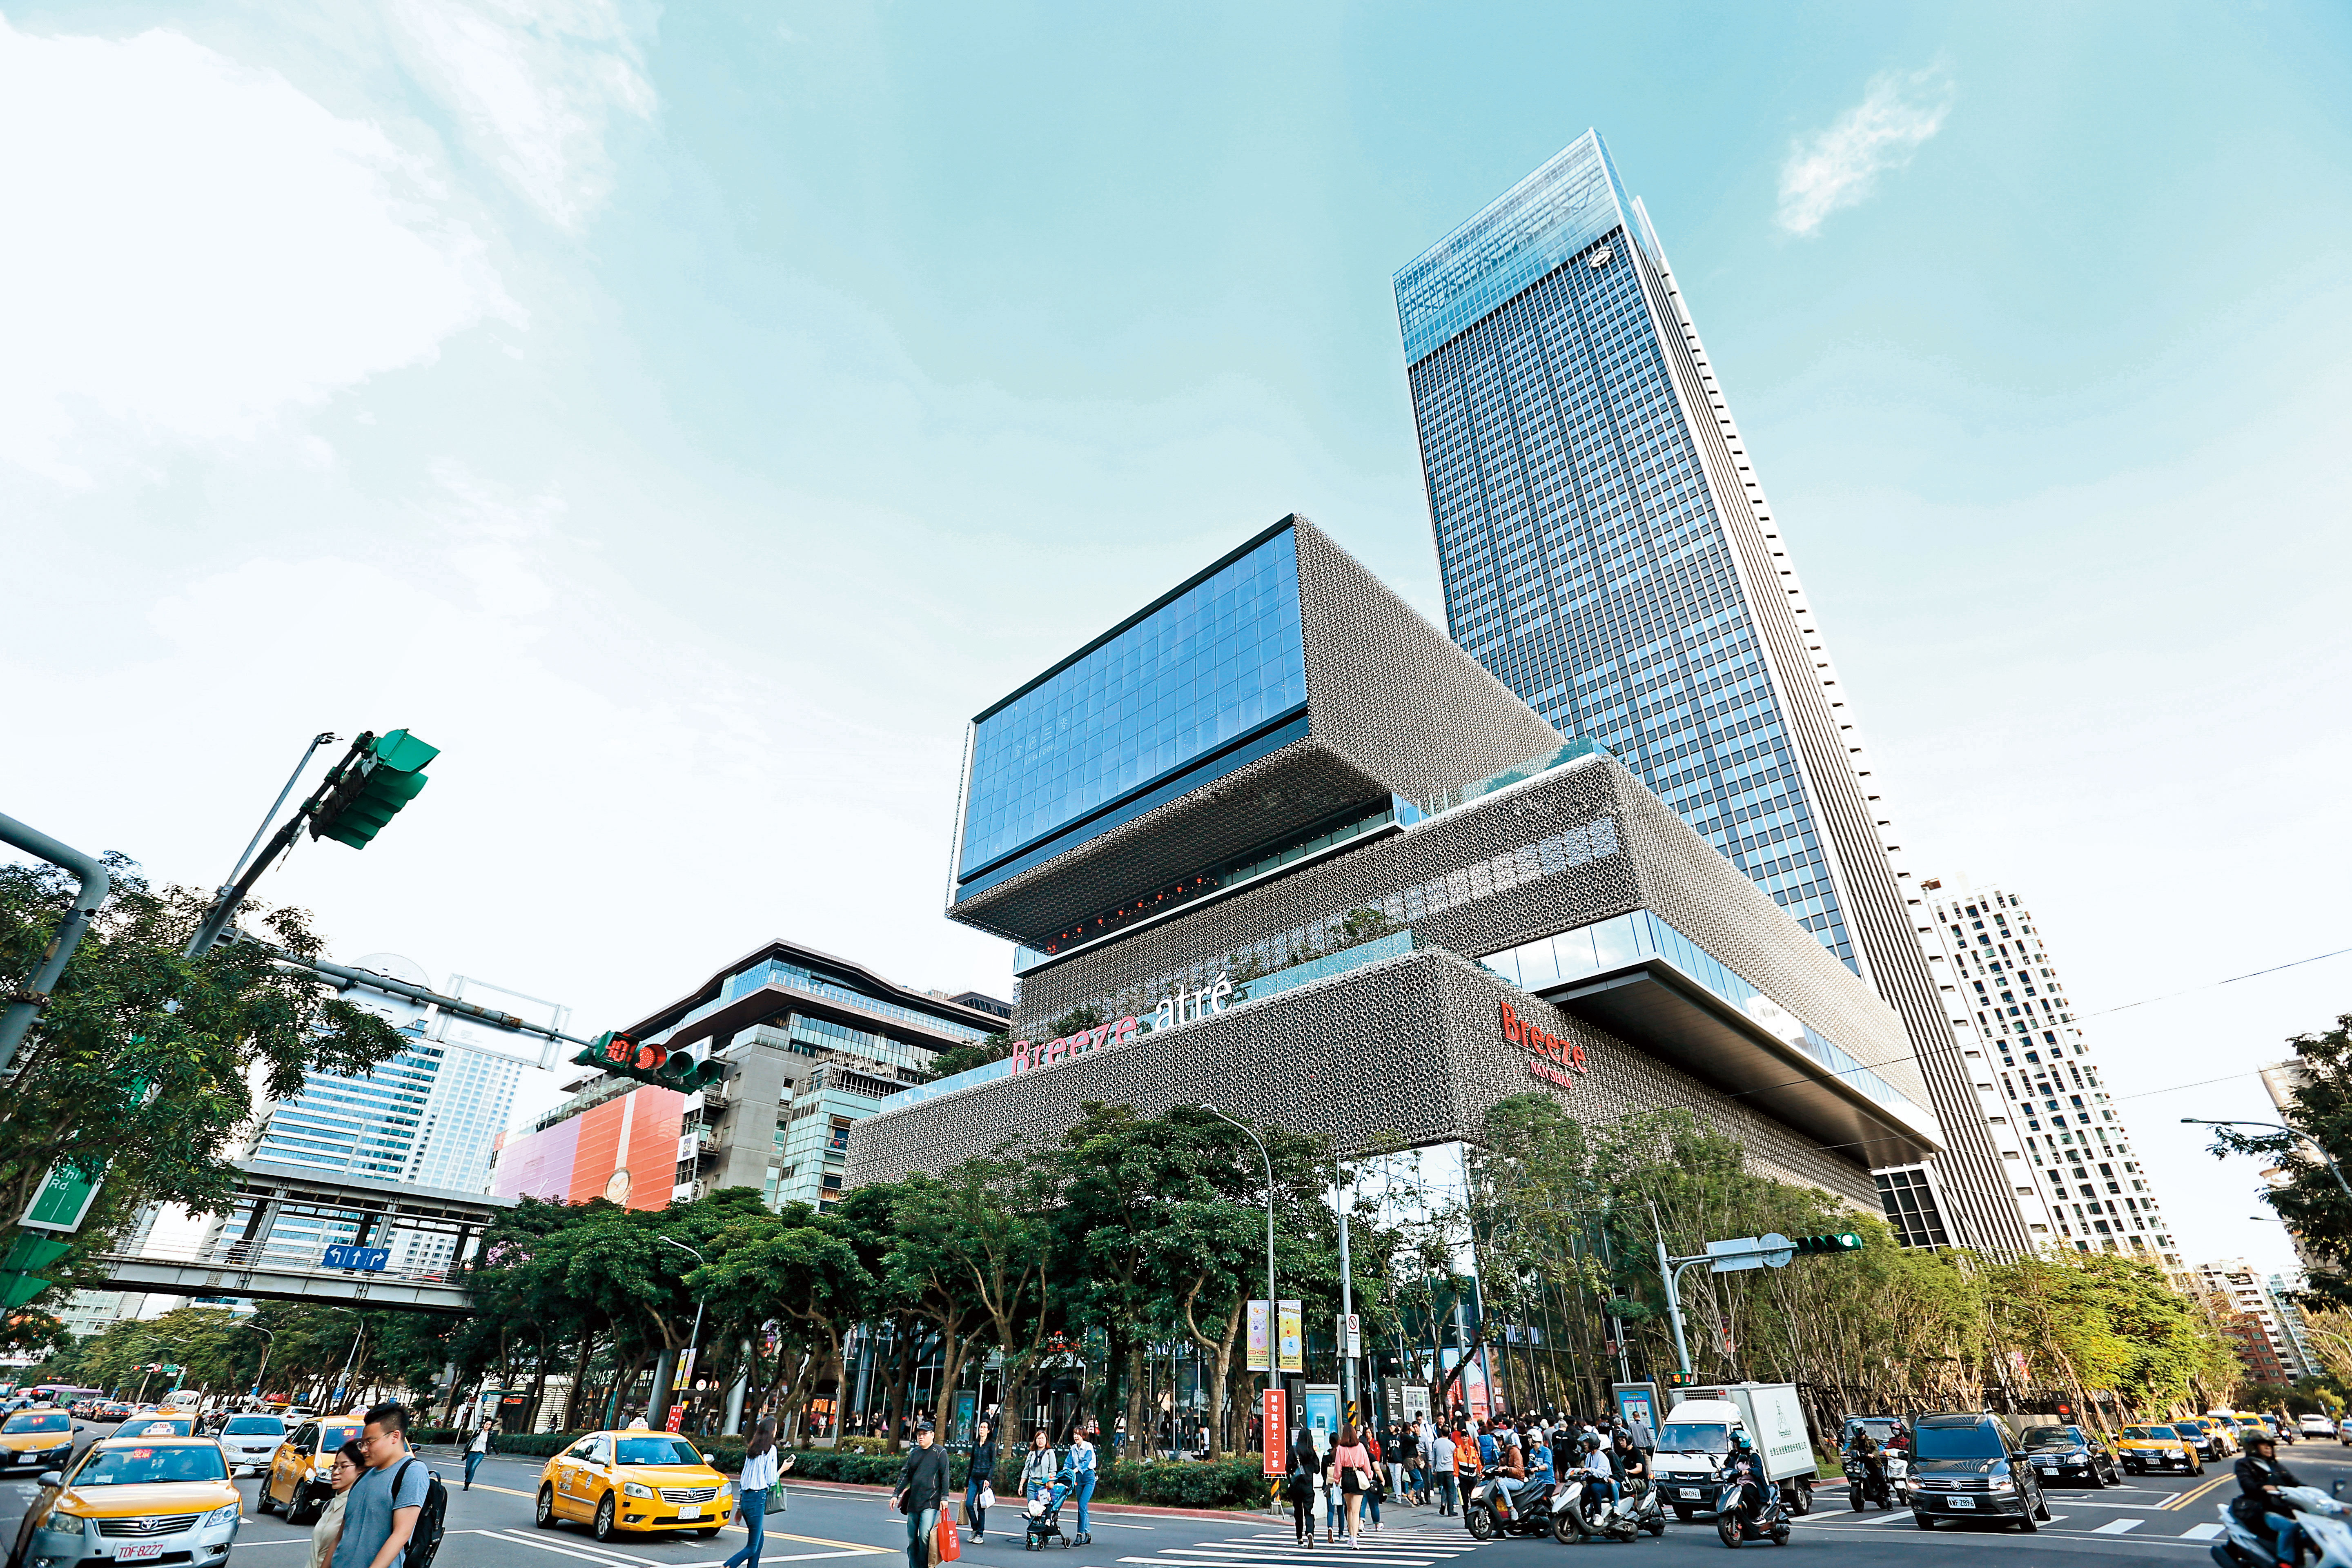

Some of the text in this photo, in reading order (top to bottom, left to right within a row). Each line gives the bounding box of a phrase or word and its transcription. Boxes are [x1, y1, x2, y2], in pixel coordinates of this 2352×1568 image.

[1011, 971, 1239, 1076] Breeze atré
[1501, 1001, 1588, 1074] Breeze
[605, 1040, 629, 1062] 40
[1530, 1060, 1574, 1089] NAN SHAN
[683, 1143, 691, 1153] GU
[49, 1178, 69, 1191] Rd.
[1296, 1404, 1304, 1422] P
[1271, 1395, 1279, 1468] 請勿臨停上、下客
[119, 1544, 164, 1558] TDF-8227
